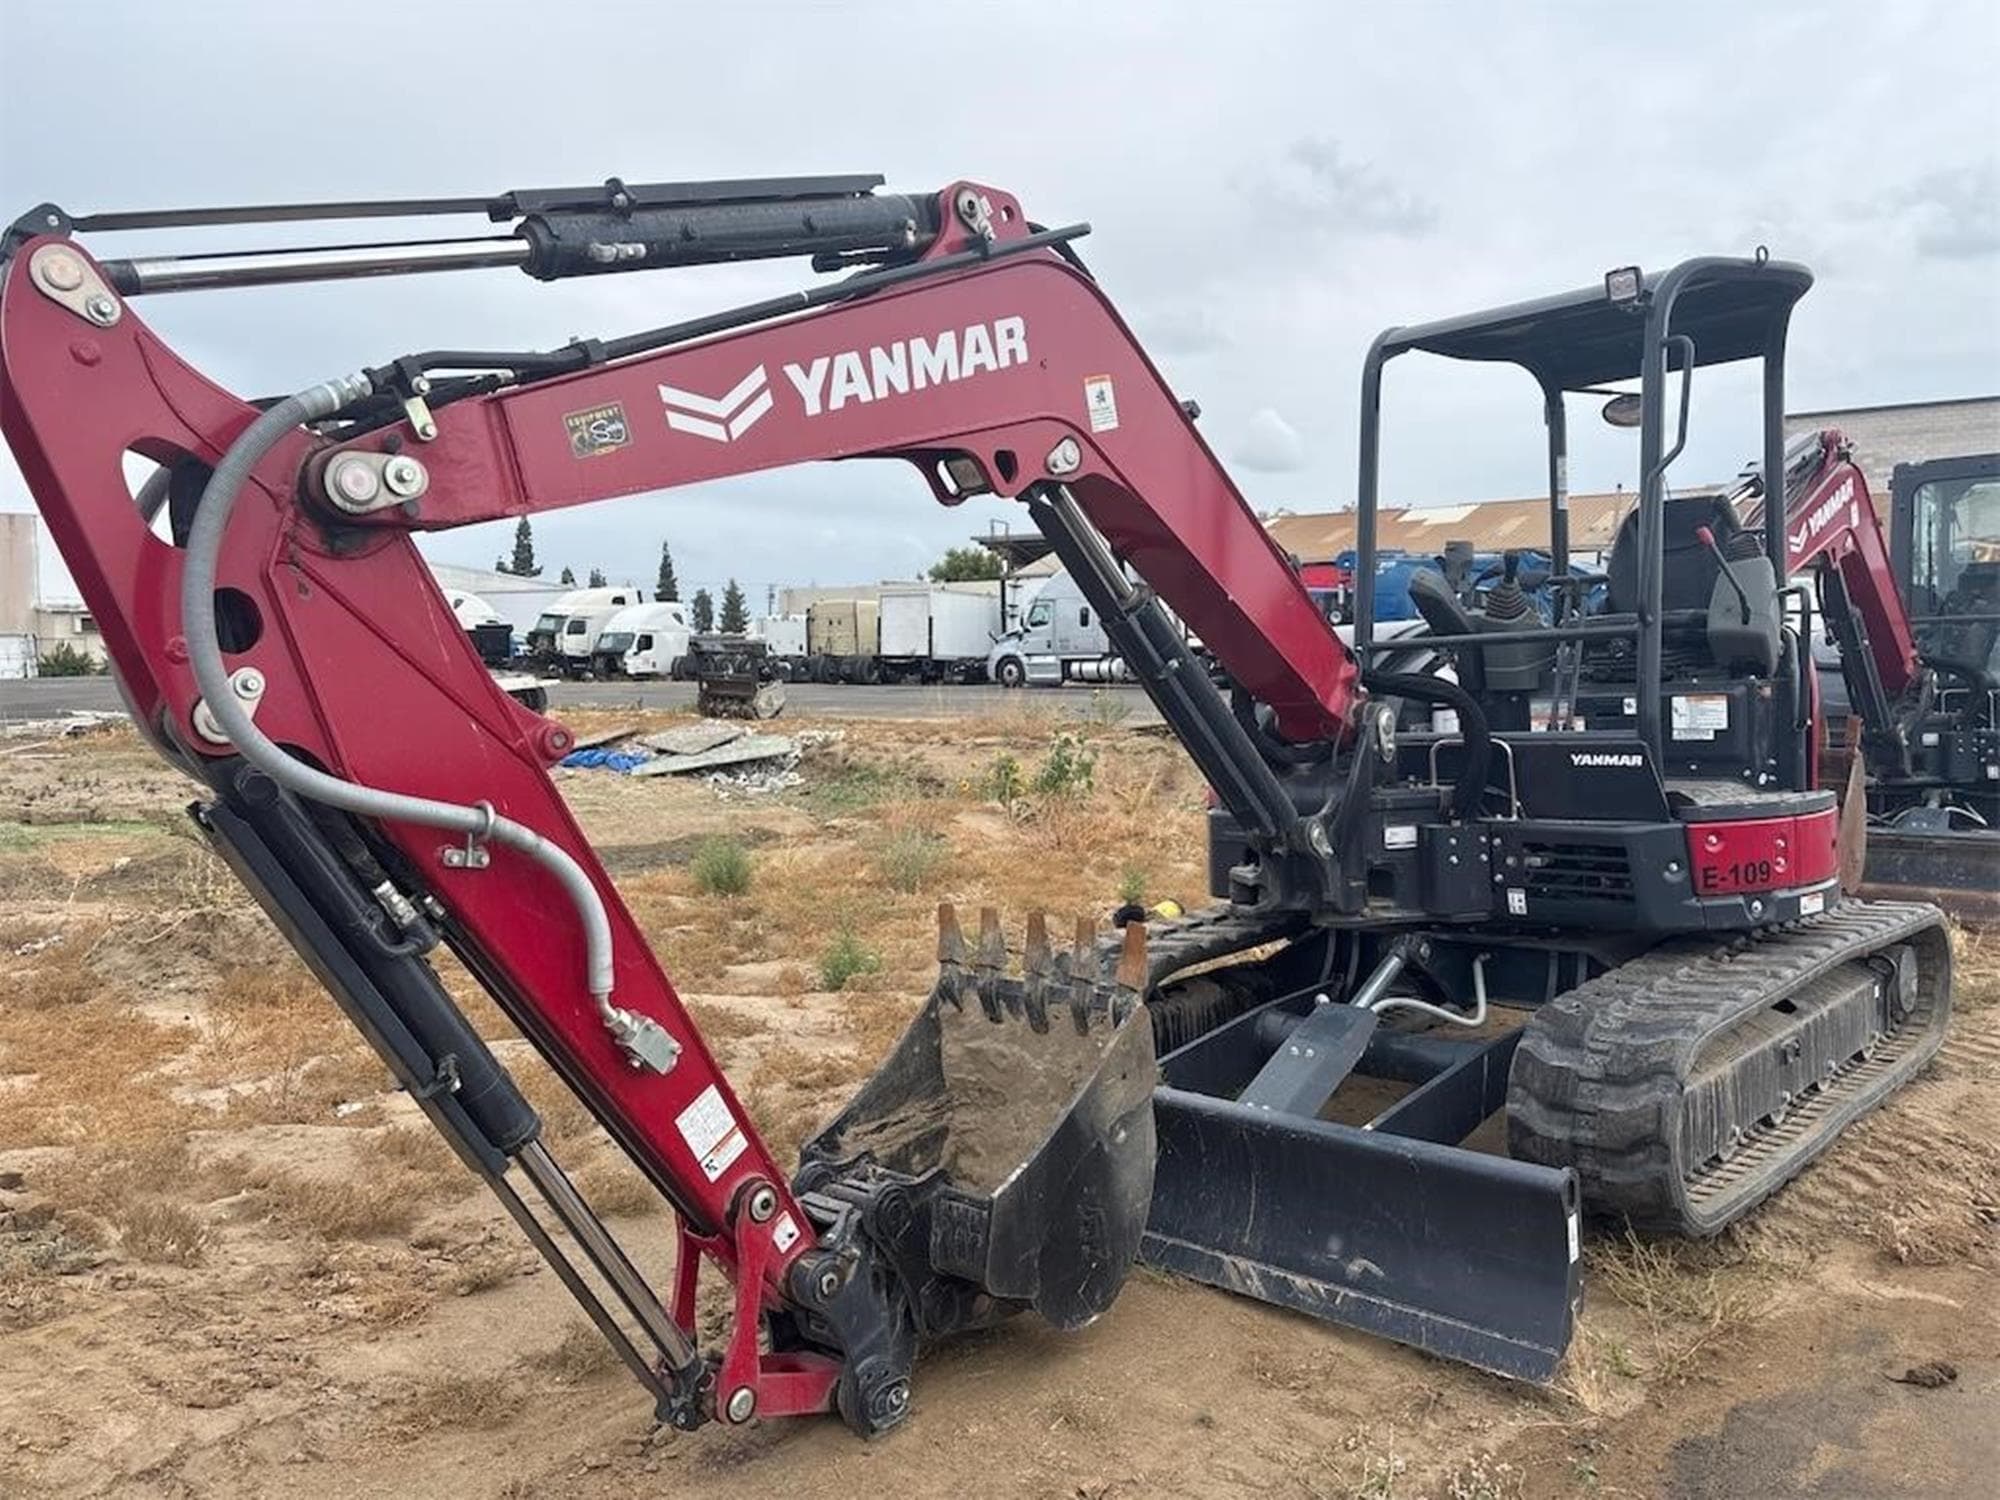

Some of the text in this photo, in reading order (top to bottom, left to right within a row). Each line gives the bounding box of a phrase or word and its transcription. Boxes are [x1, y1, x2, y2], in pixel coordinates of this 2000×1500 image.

[783, 316, 1029, 416] YANMAR
[1570, 753, 1643, 766] YANMAR
[1702, 860, 1771, 889] E-109
